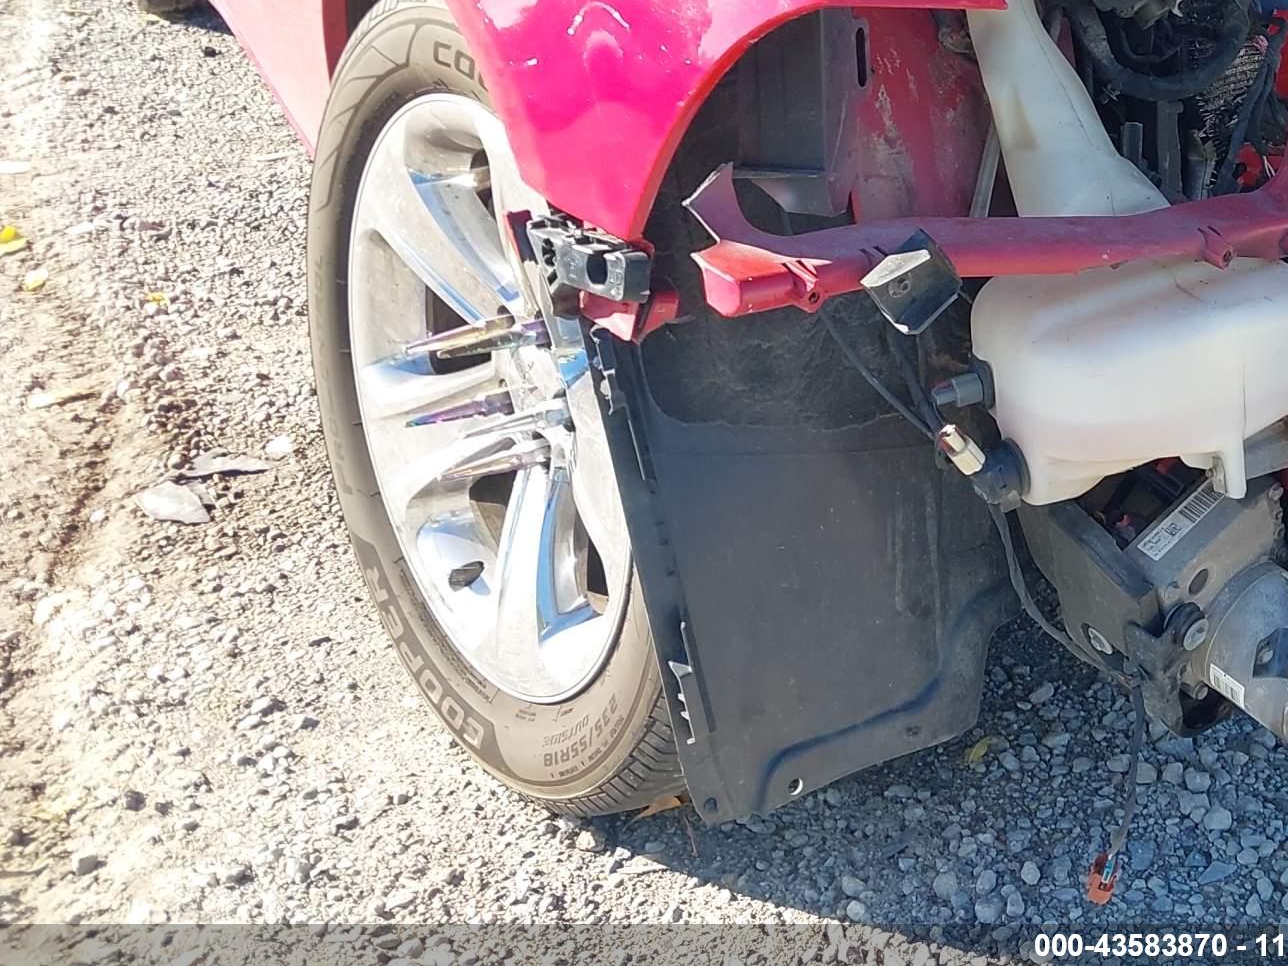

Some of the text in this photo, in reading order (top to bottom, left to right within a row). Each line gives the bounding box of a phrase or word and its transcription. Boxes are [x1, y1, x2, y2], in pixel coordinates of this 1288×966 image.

[366, 566, 485, 750] COOPER
[542, 714, 589, 748] OUTSIDE
[543, 693, 618, 767] 235/55R18
